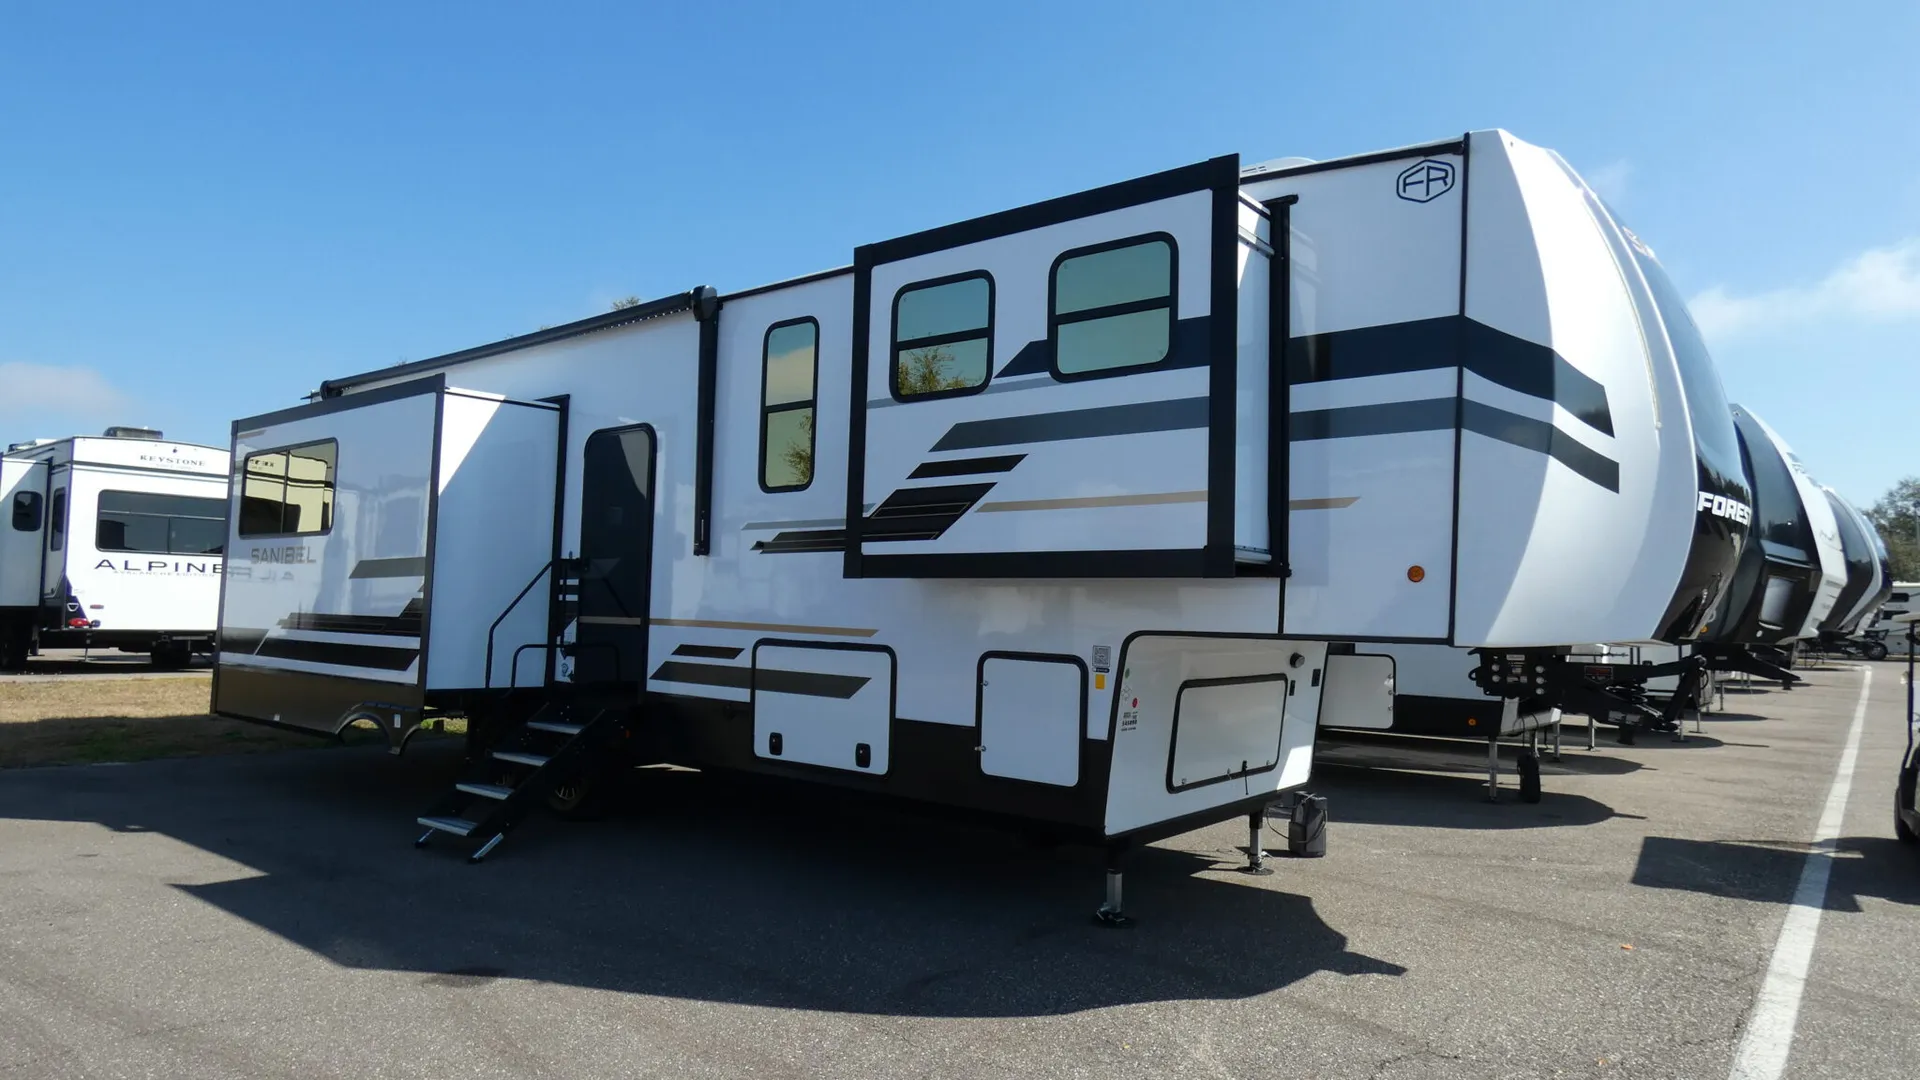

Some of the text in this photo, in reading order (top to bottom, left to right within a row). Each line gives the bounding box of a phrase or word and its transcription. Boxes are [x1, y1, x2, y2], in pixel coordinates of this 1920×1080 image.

[1402, 165, 1449, 197] FR
[140, 454, 206, 467] KEYSTONE
[250, 546, 317, 565] SANIBEL
